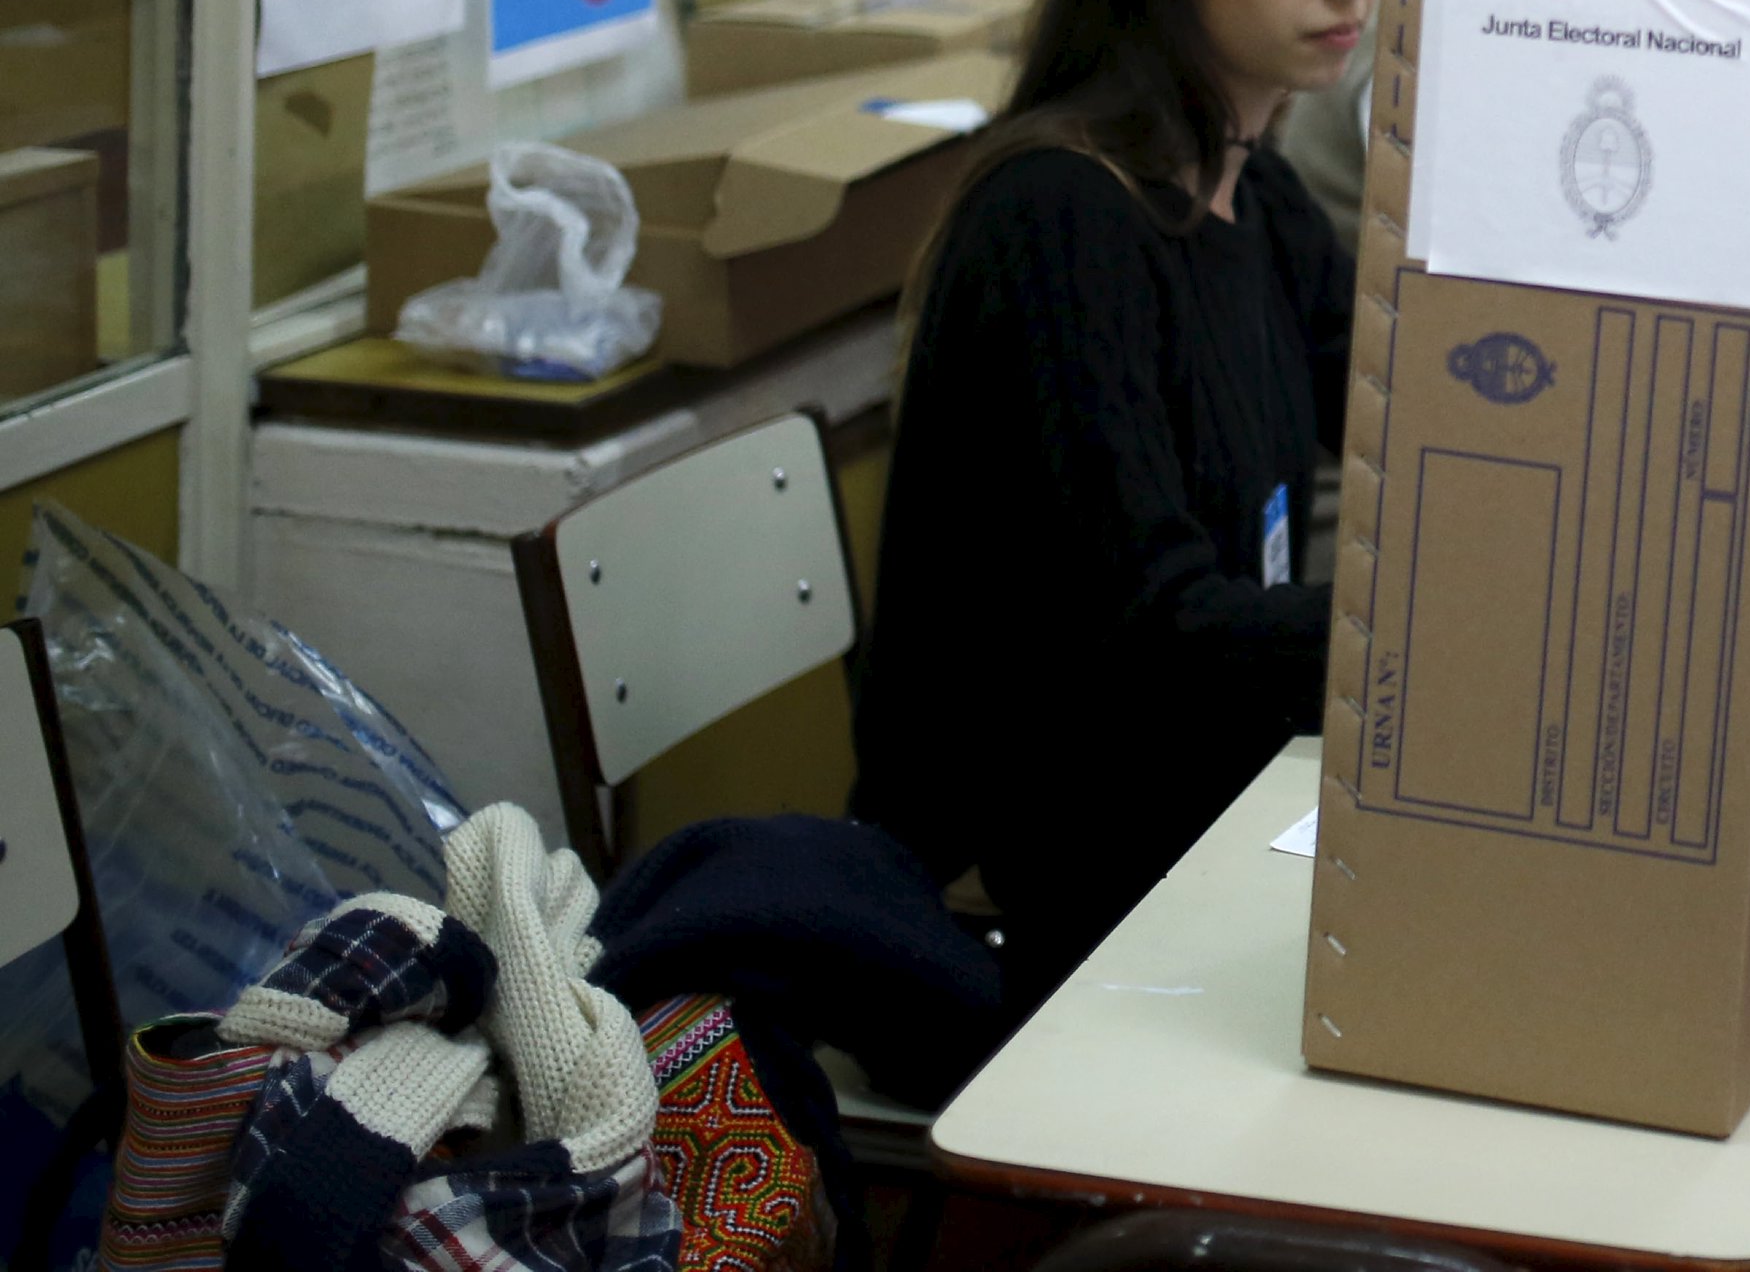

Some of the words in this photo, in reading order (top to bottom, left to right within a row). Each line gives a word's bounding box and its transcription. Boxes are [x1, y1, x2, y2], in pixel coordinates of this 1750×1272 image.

[1482, 14, 1543, 39] Junta
[1548, 20, 1641, 49] Electoral
[1648, 30, 1742, 60] Nacional
[1371, 694, 1396, 768] URNA
